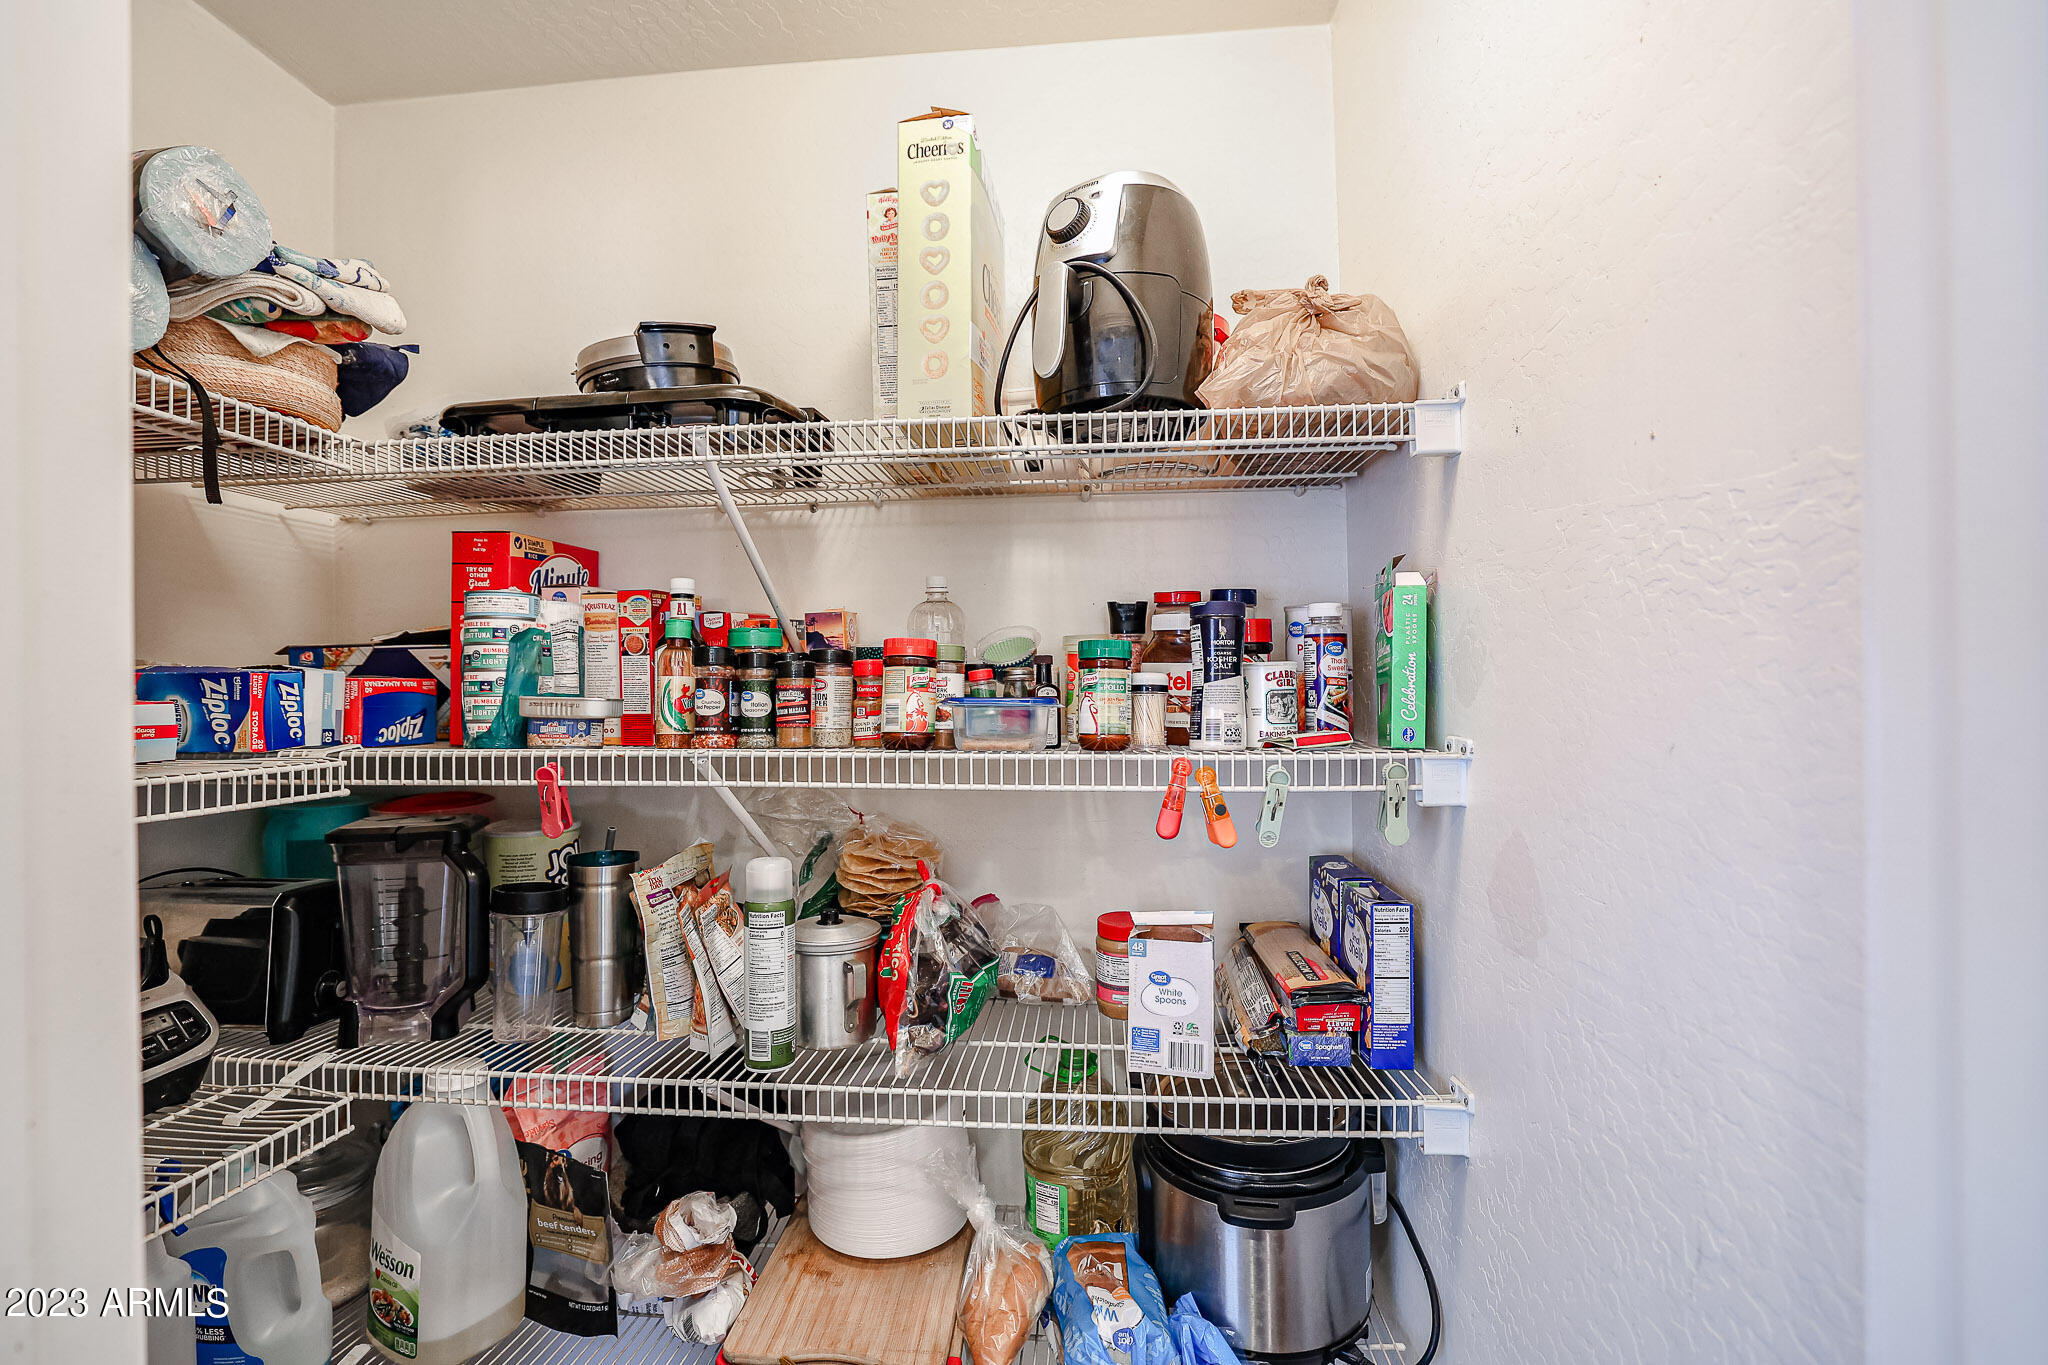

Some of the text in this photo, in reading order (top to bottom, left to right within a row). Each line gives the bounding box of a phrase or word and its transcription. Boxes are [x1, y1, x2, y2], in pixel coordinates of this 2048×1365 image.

[907, 142, 964, 160] Cheerios
[528, 539, 544, 549] SIMPLE
[468, 579, 491, 589] Great
[530, 564, 590, 595] Minute
[1402, 593, 1413, 606] 24
[584, 602, 616, 611] KRUSTEAZ
[1276, 678, 1295, 688] GIRL
[1400, 651, 1418, 721] Celebration
[200, 677, 232, 745] Ziploc
[278, 682, 303, 739] Ziploc
[378, 715, 424, 743] Ziploc
[1260, 730, 1286, 738] BAKING
[325, 731, 332, 743] 20
[257, 739, 264, 749] 20
[648, 876, 662, 885] TEXAS
[1131, 942, 1144, 951] 48
[1158, 987, 1183, 997] White
[1154, 995, 1187, 1006] Spoons
[1314, 1043, 1344, 1051] Spaghetti
[537, 1217, 597, 1237] beef tenders
[370, 1236, 415, 1280] Wesson
